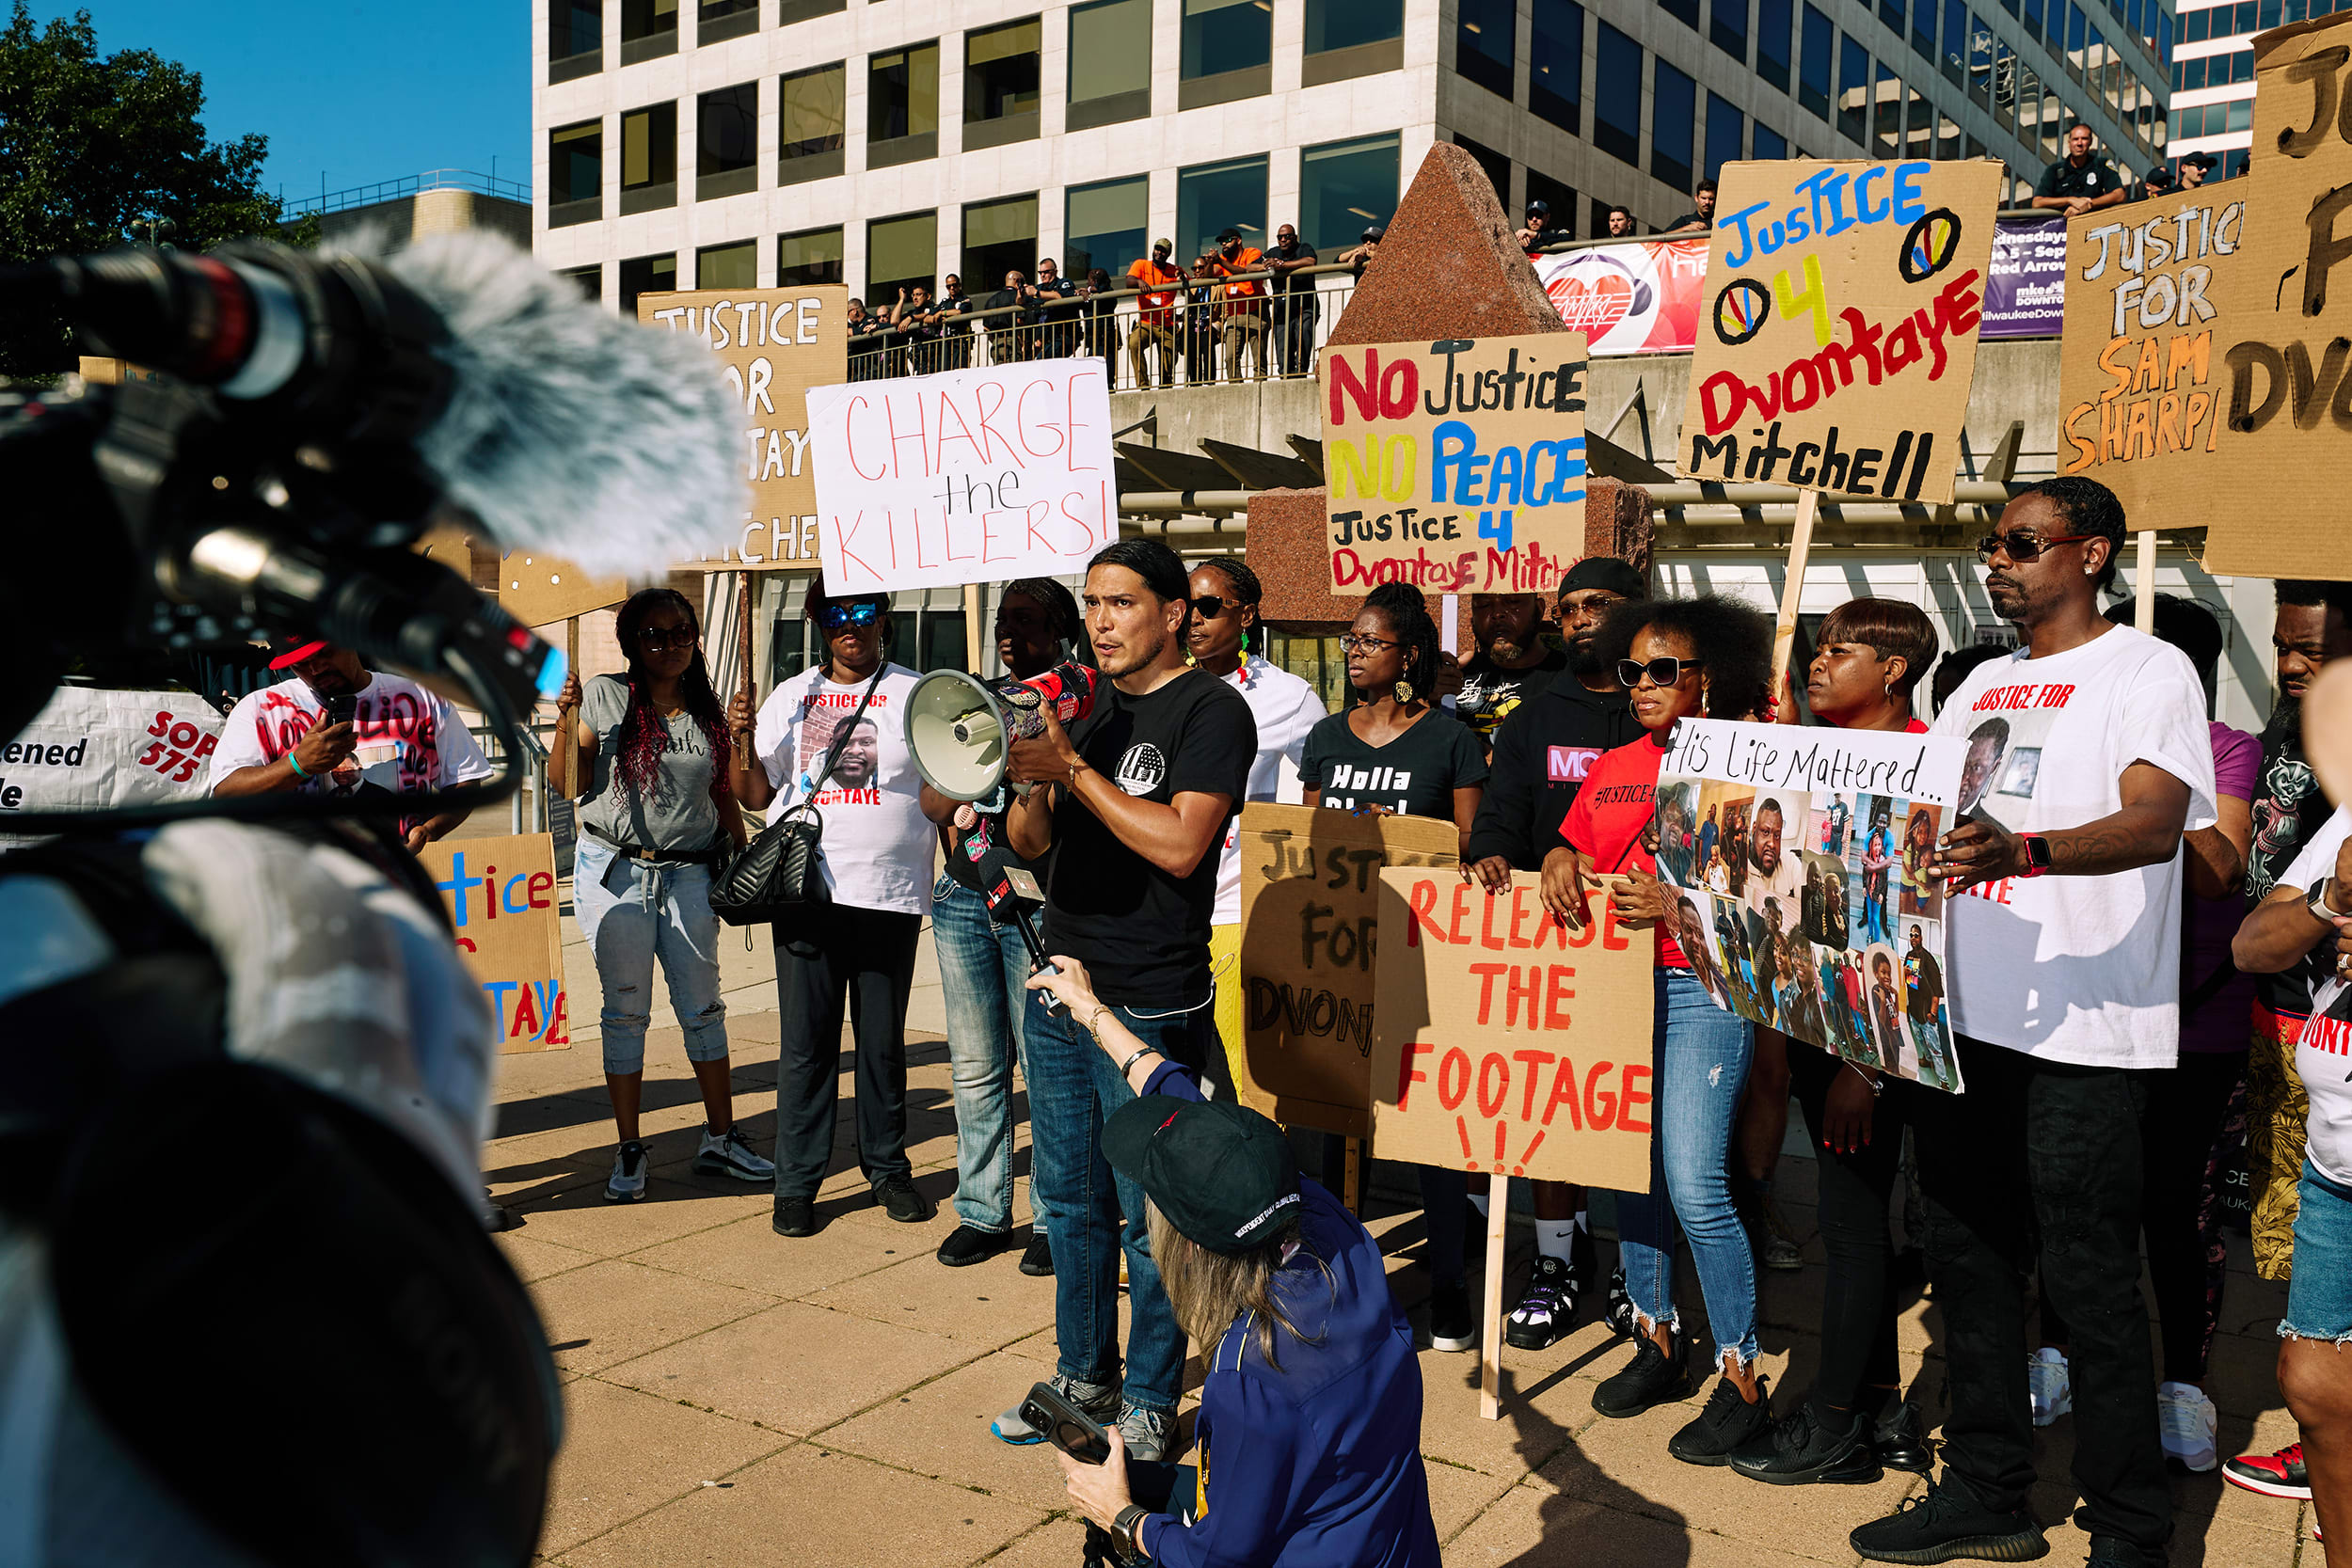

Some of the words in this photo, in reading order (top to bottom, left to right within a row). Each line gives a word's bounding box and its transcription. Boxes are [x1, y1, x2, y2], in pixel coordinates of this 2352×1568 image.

[1993, 230, 2067, 245] dnesdays
[2010, 247, 2021, 261] 5
[2082, 201, 2245, 281] JUSTIC
[1773, 253, 1832, 347] 4
[1981, 309, 2064, 321] ilwaukeeDow
[2110, 264, 2217, 339] FOR
[1329, 348, 1419, 425] NO
[2098, 329, 2212, 404] SAM
[847, 372, 1099, 481] CHARGE
[2063, 388, 2222, 475] SHARP
[933, 470, 1028, 515] the
[1329, 433, 1417, 503] NO
[1431, 420, 1586, 507] PEACE
[1478, 511, 1514, 552] 4
[803, 694, 858, 707] JUSTICE
[862, 693, 887, 707] OR
[1972, 685, 2039, 711] JUSTICE
[2033, 684, 2075, 708] FOR
[0, 738, 87, 766] ened
[138, 741, 200, 783] 575
[147, 710, 219, 758] SOP
[1329, 765, 1411, 790] Holla
[1726, 731, 1778, 783] Life
[1780, 742, 1942, 803] Mattered...
[1407, 879, 1629, 950] RELEASE
[1469, 962, 1577, 1031] THE
[1397, 1042, 1653, 1132] FOOTAGE
[1455, 1115, 1547, 1177] !!!
